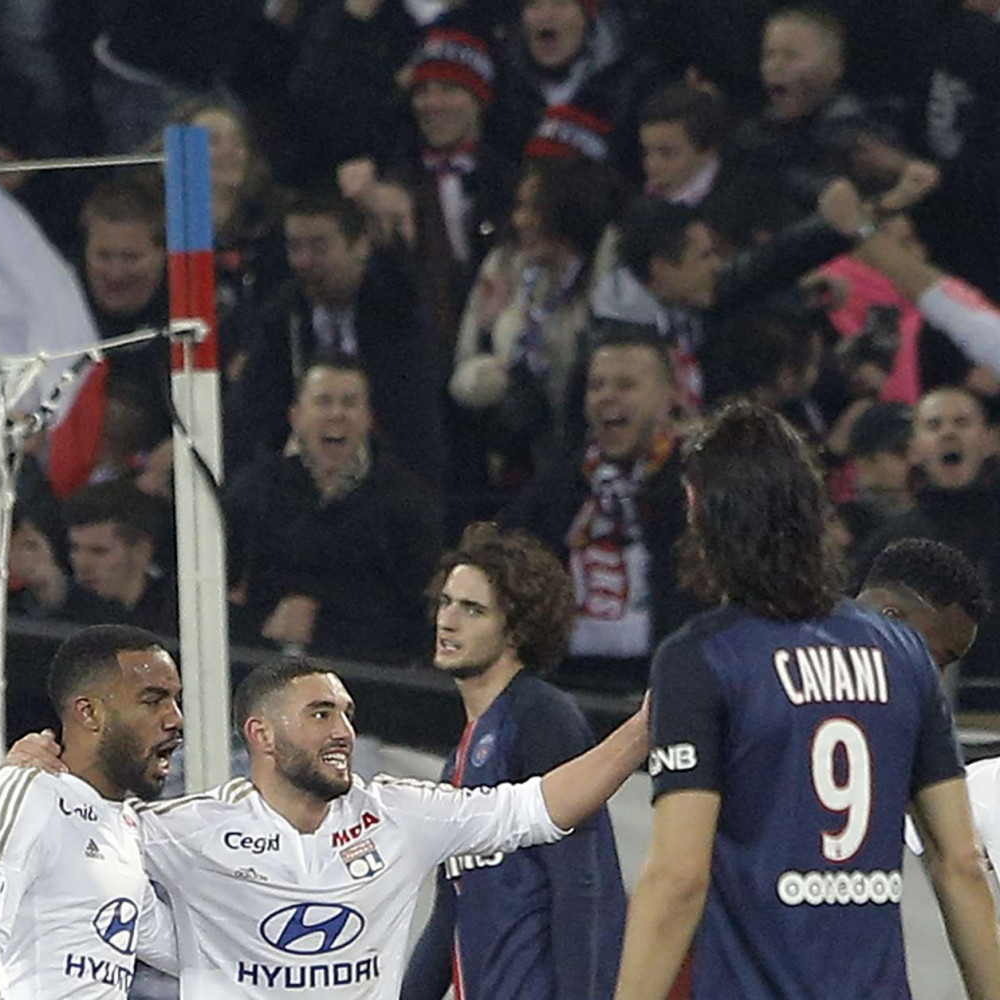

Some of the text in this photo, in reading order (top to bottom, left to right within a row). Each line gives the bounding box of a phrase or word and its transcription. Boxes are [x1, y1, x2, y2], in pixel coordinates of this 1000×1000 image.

[774, 645, 889, 706] CAVANI
[811, 716, 872, 863] 9
[331, 811, 381, 848] MDA
[237, 955, 380, 988] HYUNDAI
